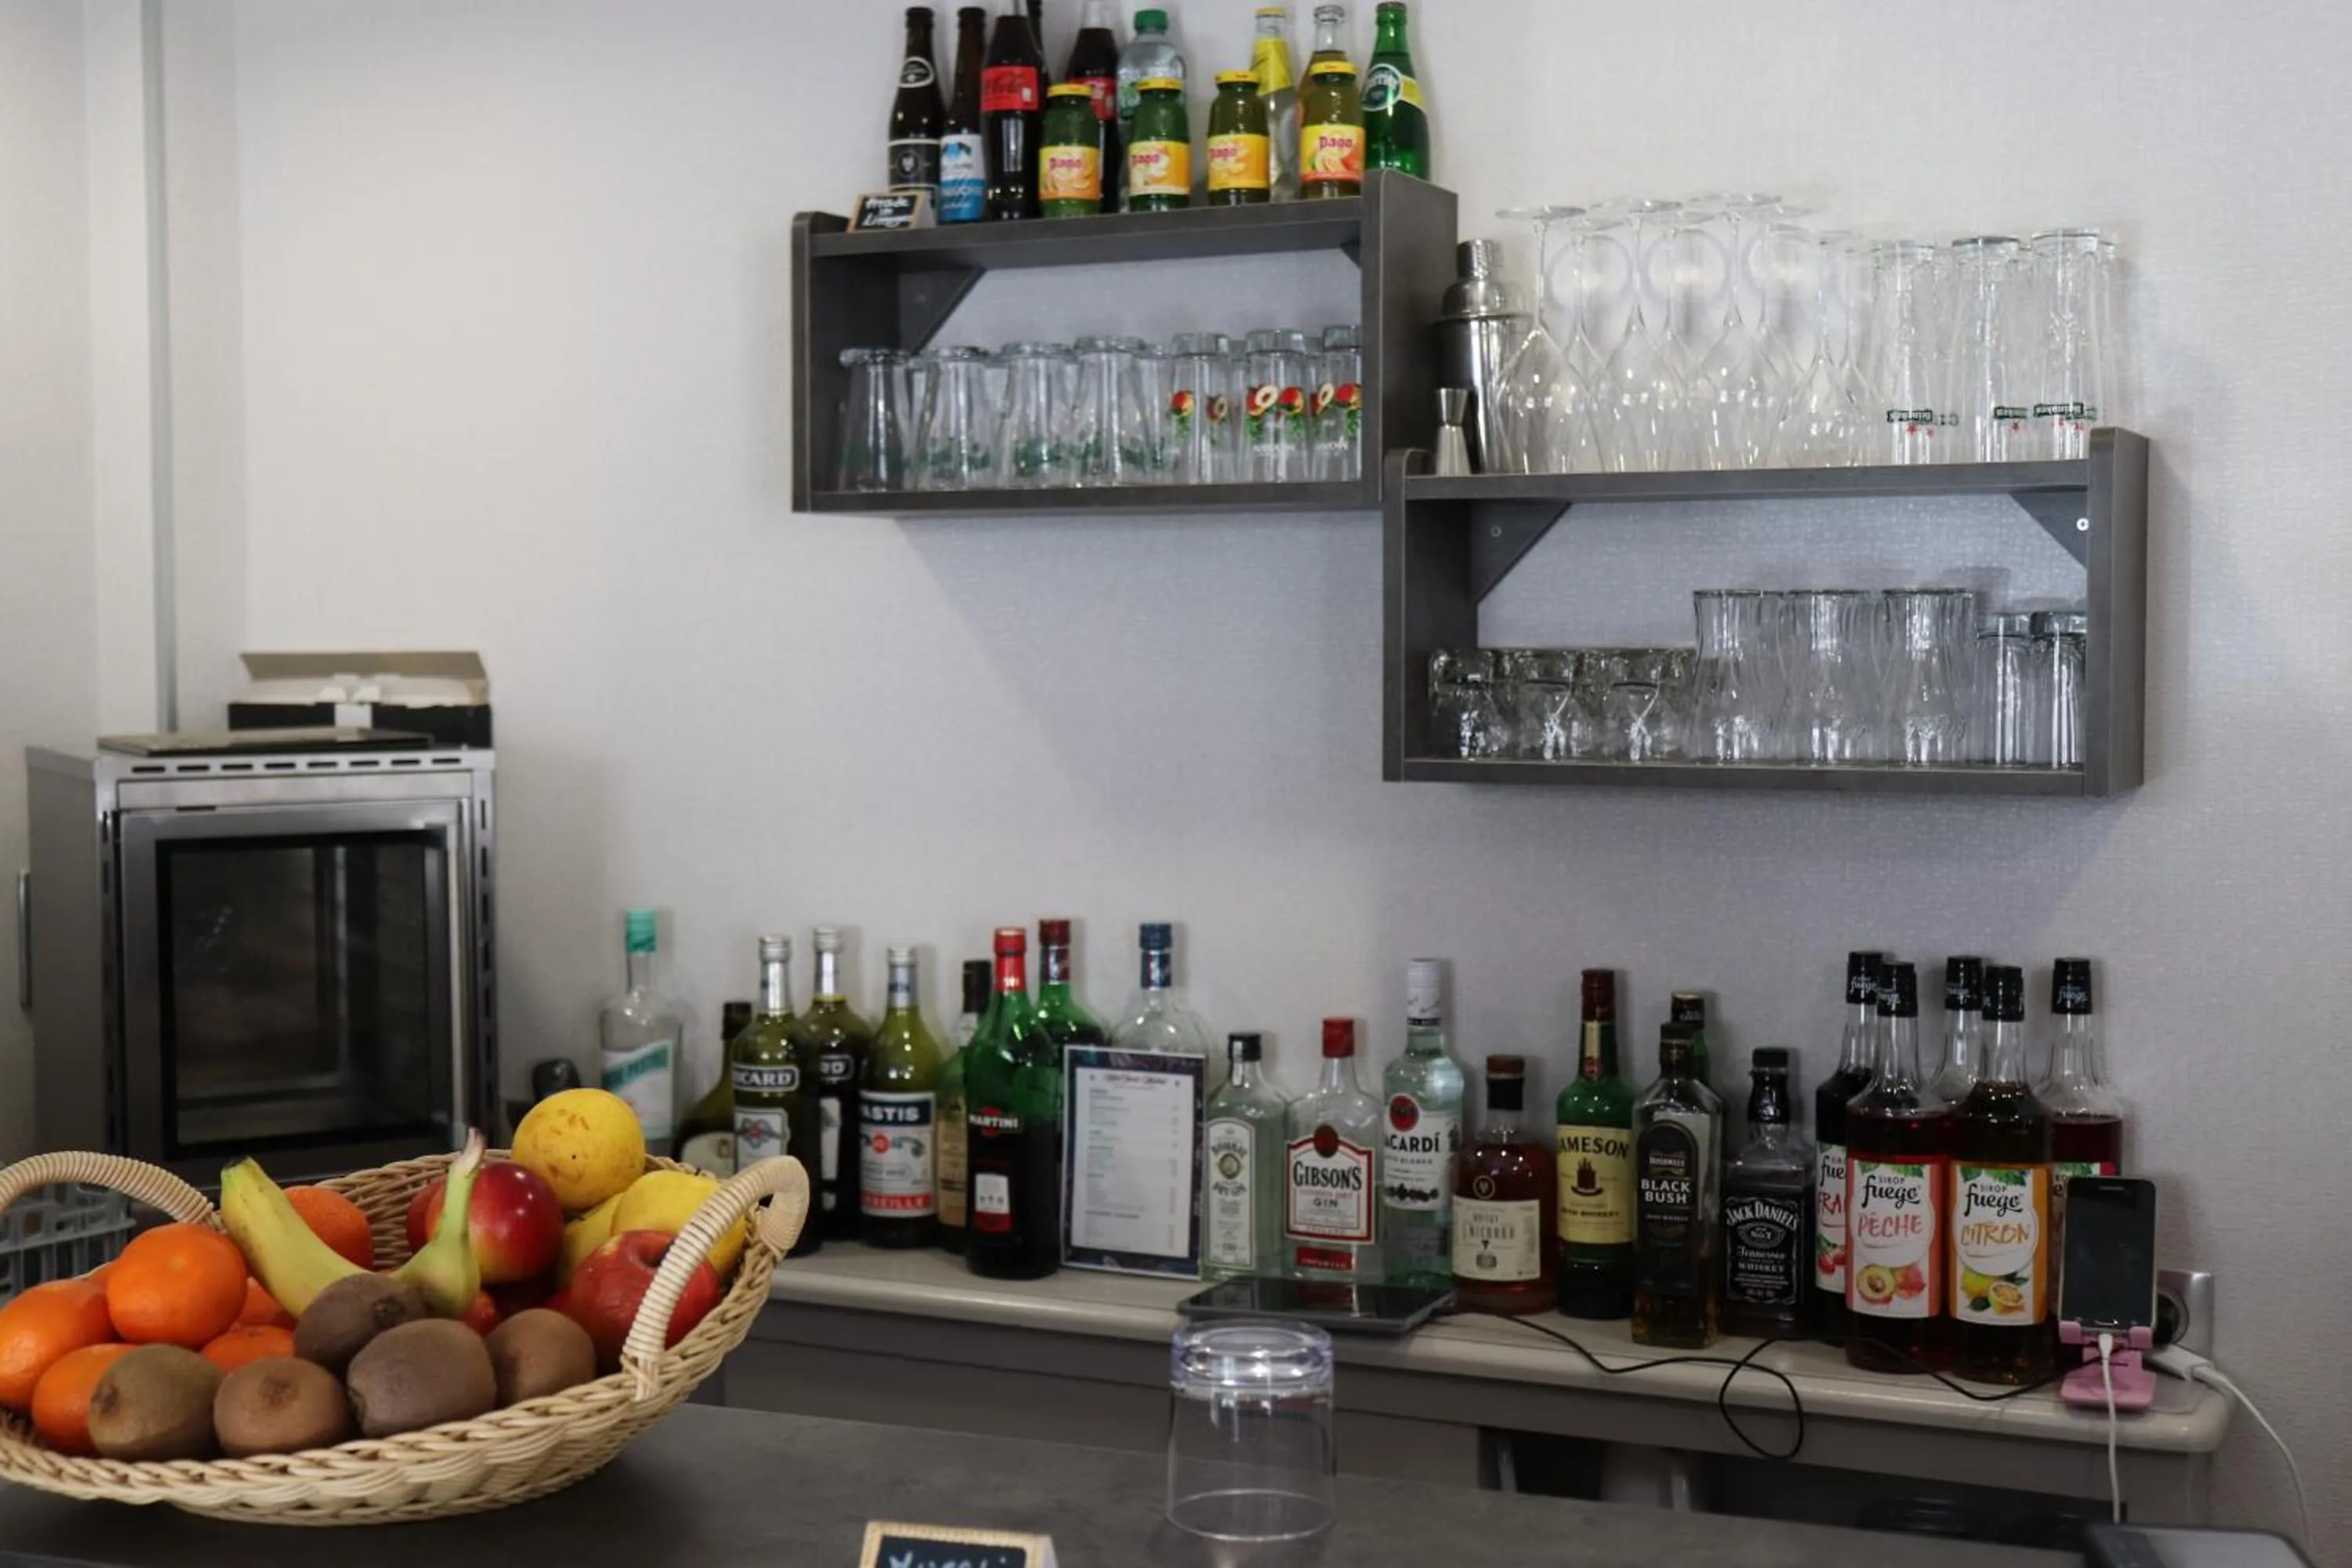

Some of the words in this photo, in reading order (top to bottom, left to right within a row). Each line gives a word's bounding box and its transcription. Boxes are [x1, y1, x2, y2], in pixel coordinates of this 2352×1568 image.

[1319, 136, 1352, 151] pago
[734, 1069, 792, 1086] ICARD
[859, 1105, 920, 1122] ASTIS
[968, 1113, 1019, 1129] MARTINI
[1385, 1131, 1440, 1152] ACARDÍ
[1559, 1135, 1629, 1159] AMESON
[1294, 1160, 1363, 1192] GIBSON'S
[1820, 1155, 1845, 1187] fue
[1641, 1178, 1690, 1193] BLACK
[1860, 1174, 1921, 1210] fuego
[1644, 1191, 1687, 1204] BUSH
[1818, 1190, 1842, 1216] FRA
[1963, 1182, 2024, 1218] fuego
[1961, 1221, 2030, 1247] CITRON
